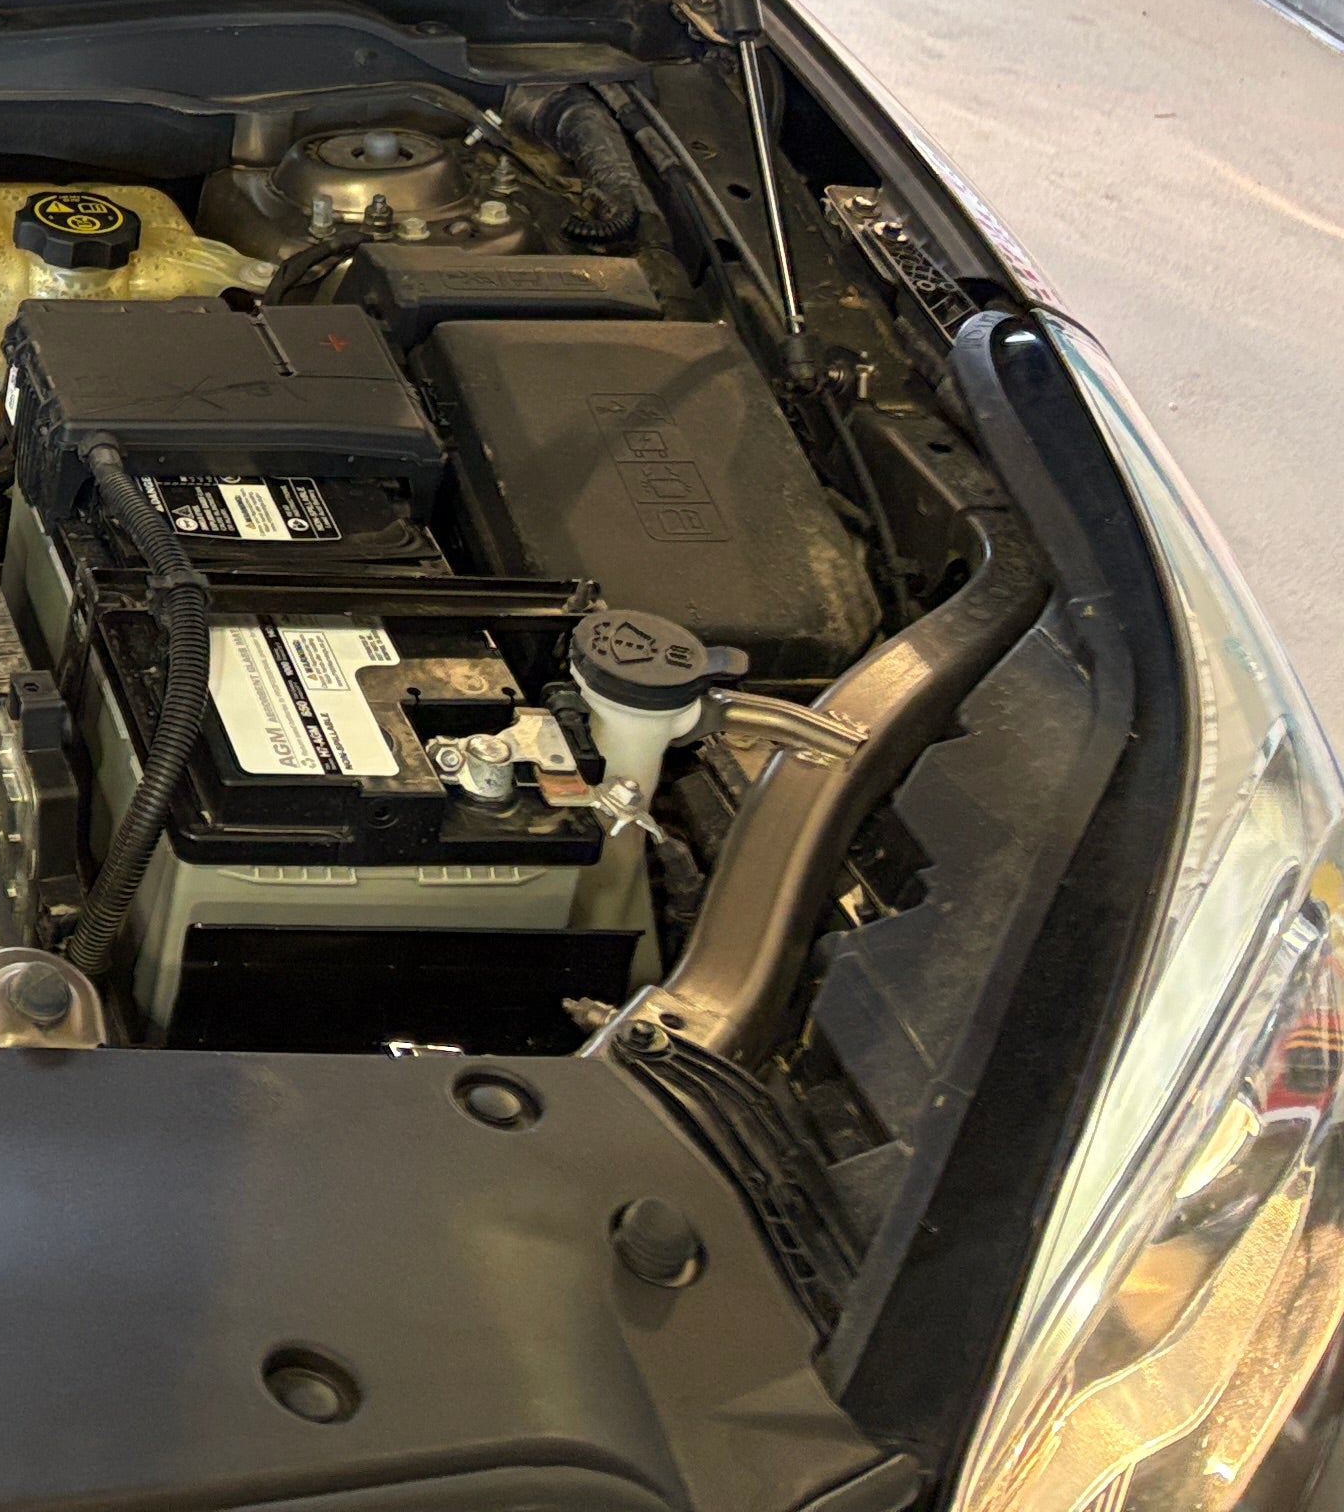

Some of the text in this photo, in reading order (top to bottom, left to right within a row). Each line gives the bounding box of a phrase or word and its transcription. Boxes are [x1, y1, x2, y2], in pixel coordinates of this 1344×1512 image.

[250, 672, 278, 723] ABSORBENT
[265, 726, 299, 769] AGM
[306, 725, 332, 758] H7-AGM
[320, 712, 354, 771] NON-SPILLABLE
